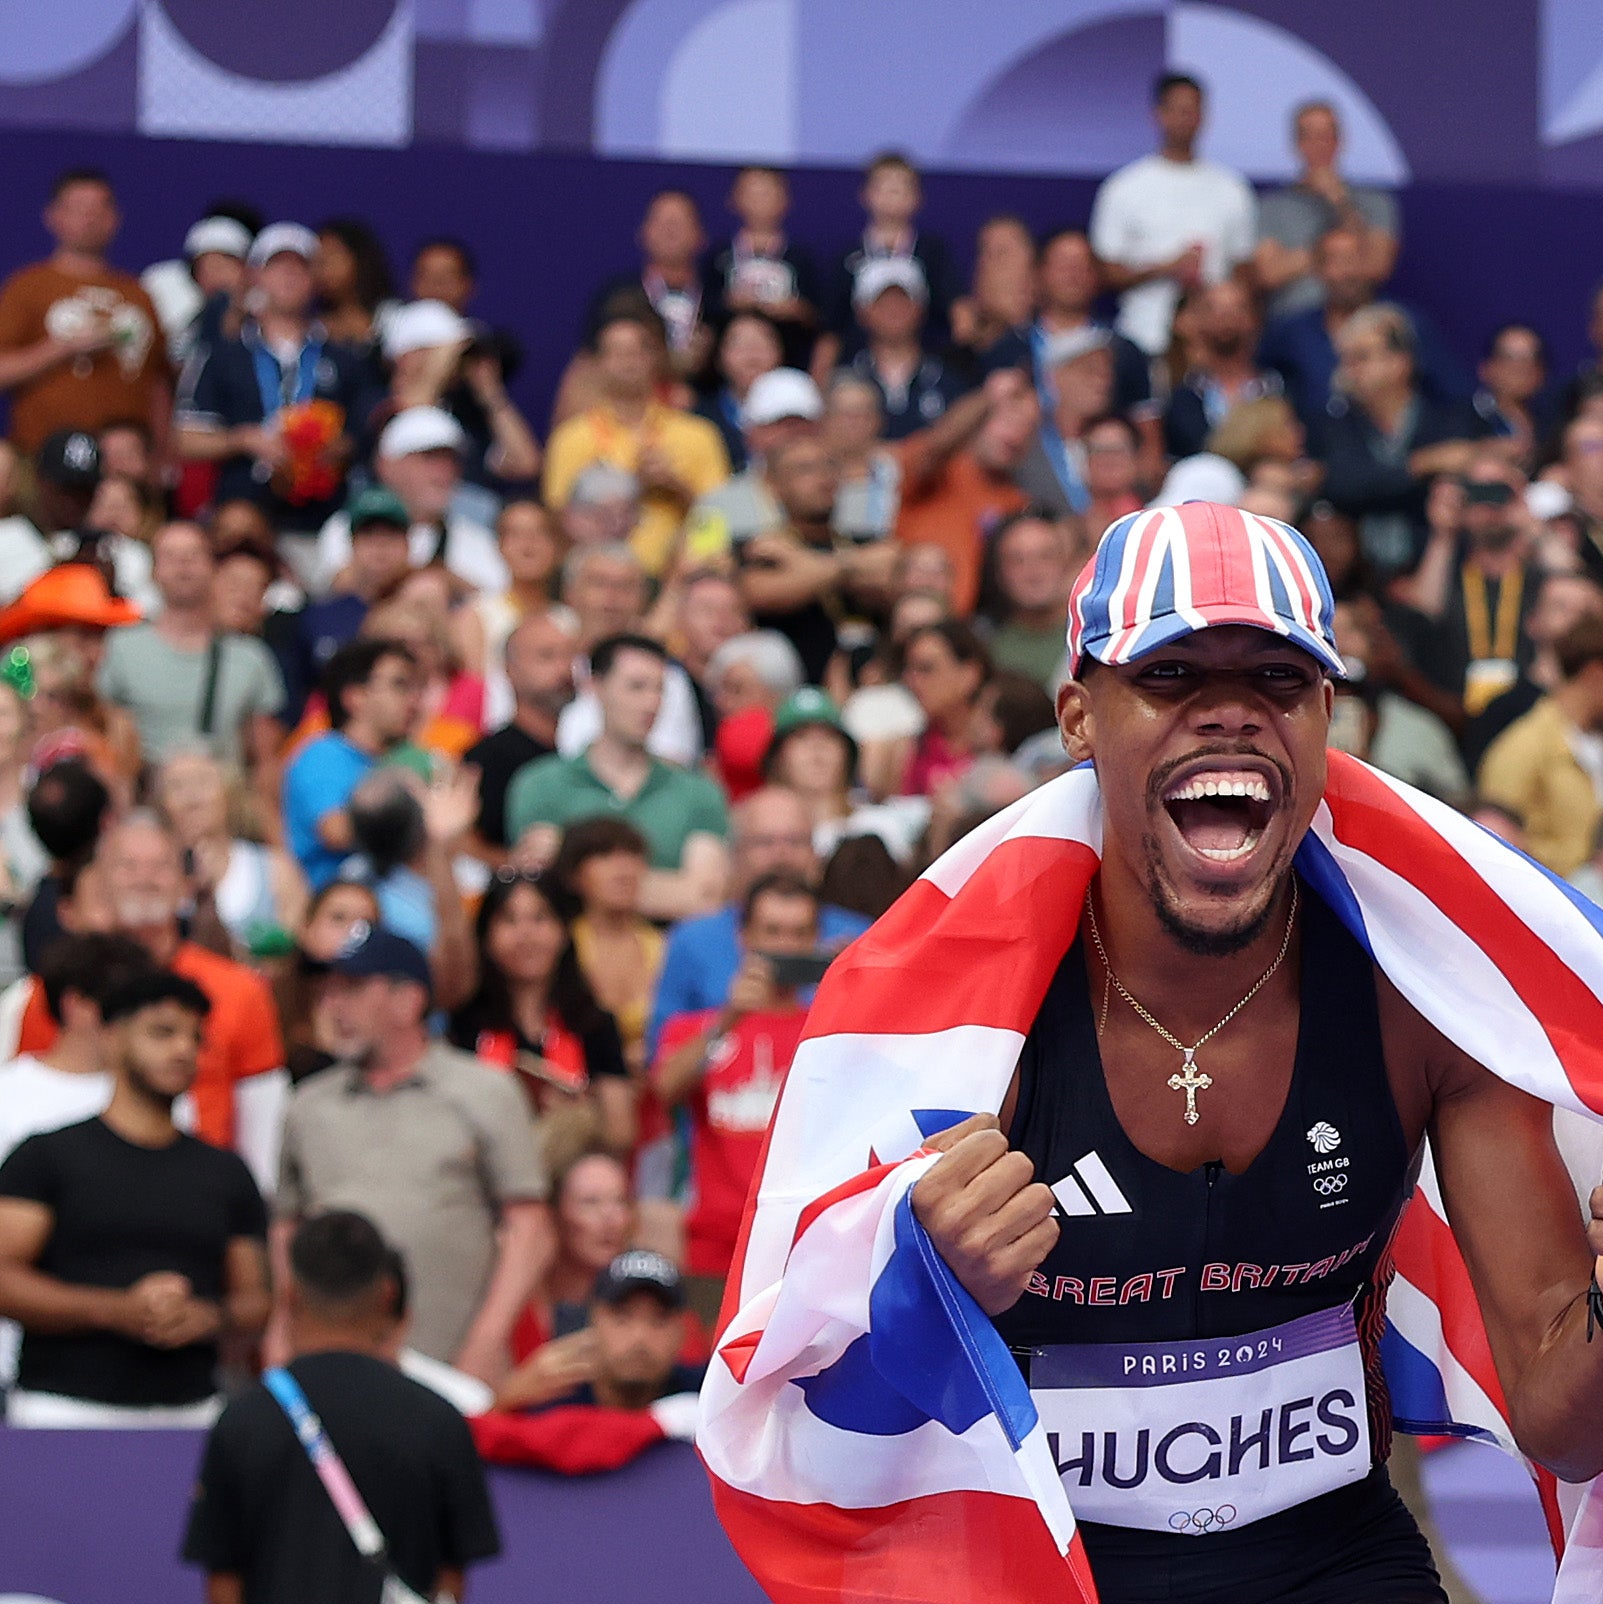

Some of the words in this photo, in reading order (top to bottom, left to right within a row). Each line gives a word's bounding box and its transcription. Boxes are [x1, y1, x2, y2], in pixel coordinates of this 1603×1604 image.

[1307, 1160, 1334, 1175] TEAM
[1334, 1157, 1350, 1169] GB
[1025, 1266, 1187, 1306] GREAT
[1200, 1231, 1376, 1293] BRITAIN
[1123, 1351, 1206, 1375] PARIS
[1217, 1336, 1283, 1368] 2024
[1046, 1388, 1360, 1490] HUGHES
